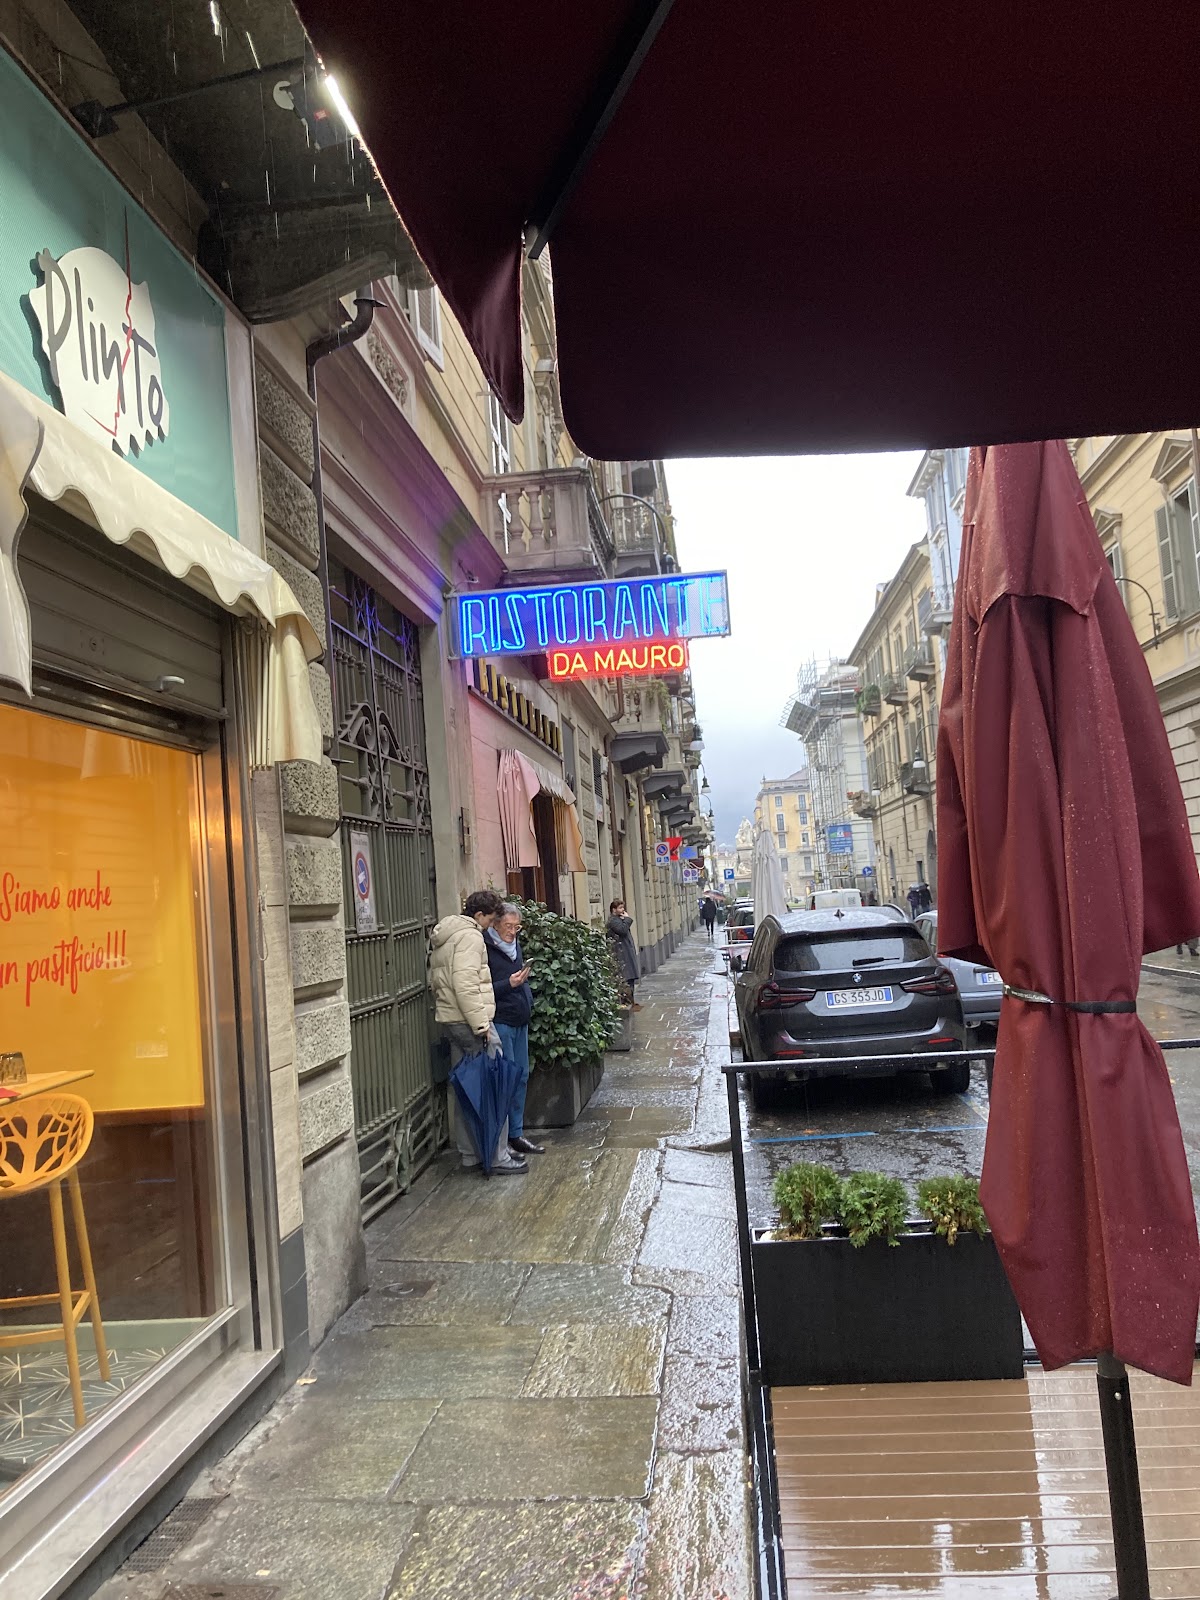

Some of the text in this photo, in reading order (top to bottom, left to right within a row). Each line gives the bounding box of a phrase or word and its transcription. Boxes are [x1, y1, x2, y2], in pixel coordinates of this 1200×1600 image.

[462, 576, 724, 654] RISTORANTE
[553, 644, 685, 676] DA MAURO
[0, 870, 112, 922] Siamo anche
